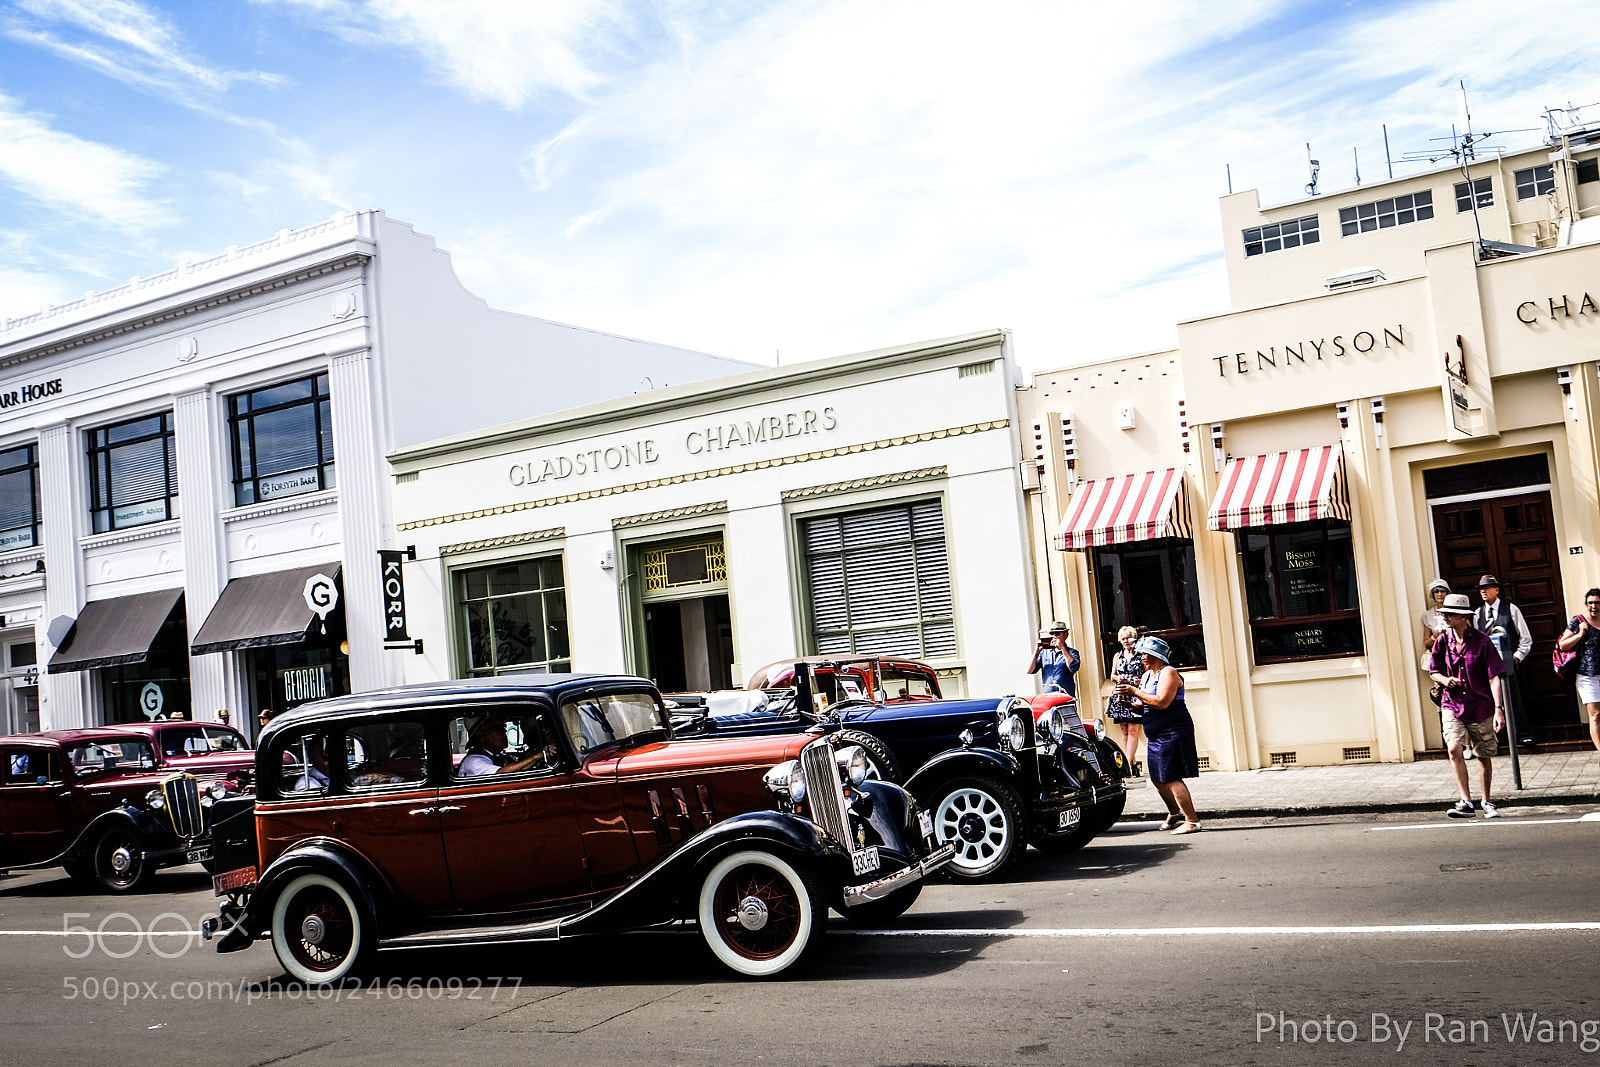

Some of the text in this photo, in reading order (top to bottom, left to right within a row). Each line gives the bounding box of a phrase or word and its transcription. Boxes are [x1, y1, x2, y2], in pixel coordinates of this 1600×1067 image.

[1213, 292, 1600, 377] TENNYSON CHA
[21, 378, 62, 403] HOUSE
[509, 406, 838, 487] GLADSTONE CHAMBERS
[271, 477, 317, 491] FORSYTH BARR
[1285, 550, 1316, 561] Bisson
[1288, 559, 1314, 568] Moss
[310, 581, 331, 607] G
[384, 561, 404, 630] KORR
[1294, 629, 1323, 638] NOTARY
[1297, 637, 1323, 646] PUBLIC
[23, 667, 39, 685] 42
[284, 667, 327, 701] GEORGIA
[143, 688, 158, 711] G
